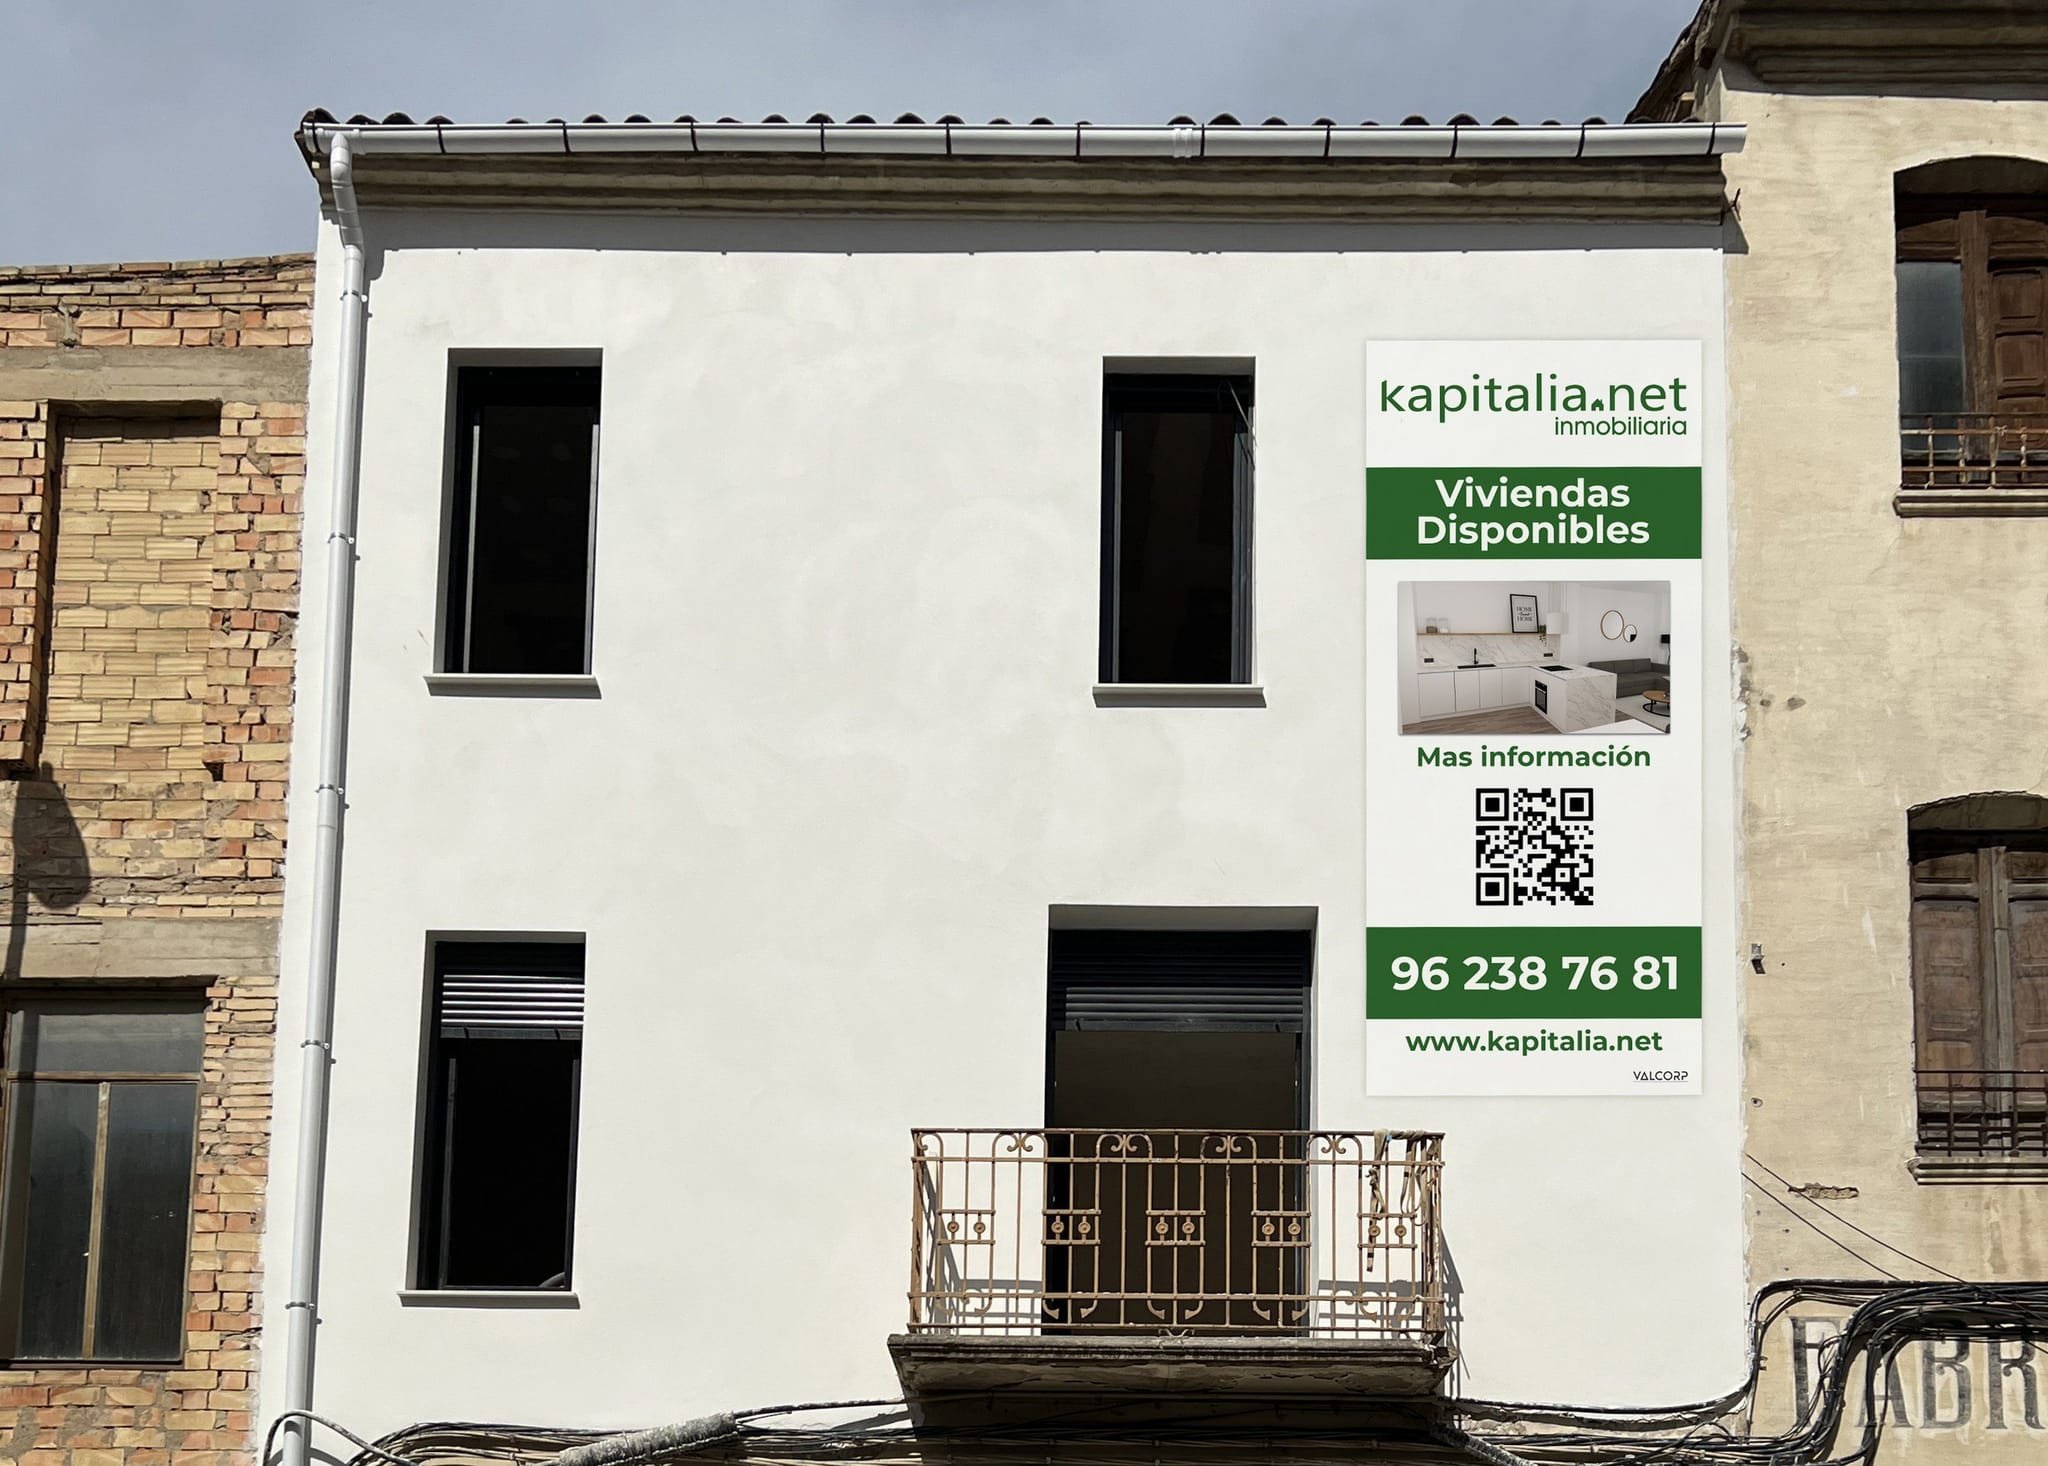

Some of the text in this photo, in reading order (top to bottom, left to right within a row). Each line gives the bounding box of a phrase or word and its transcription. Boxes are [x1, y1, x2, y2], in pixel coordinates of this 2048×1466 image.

[1554, 416, 1687, 436] inmobiliaria
[1435, 475, 1630, 508] Viviendas
[1418, 512, 1650, 551] Disponibles
[1417, 744, 1651, 768] Mas información
[1391, 956, 1678, 991] 96 238 76 81
[1405, 1029, 1664, 1057] www.kapitalia.net
[1633, 1070, 1688, 1081] VALCORP
